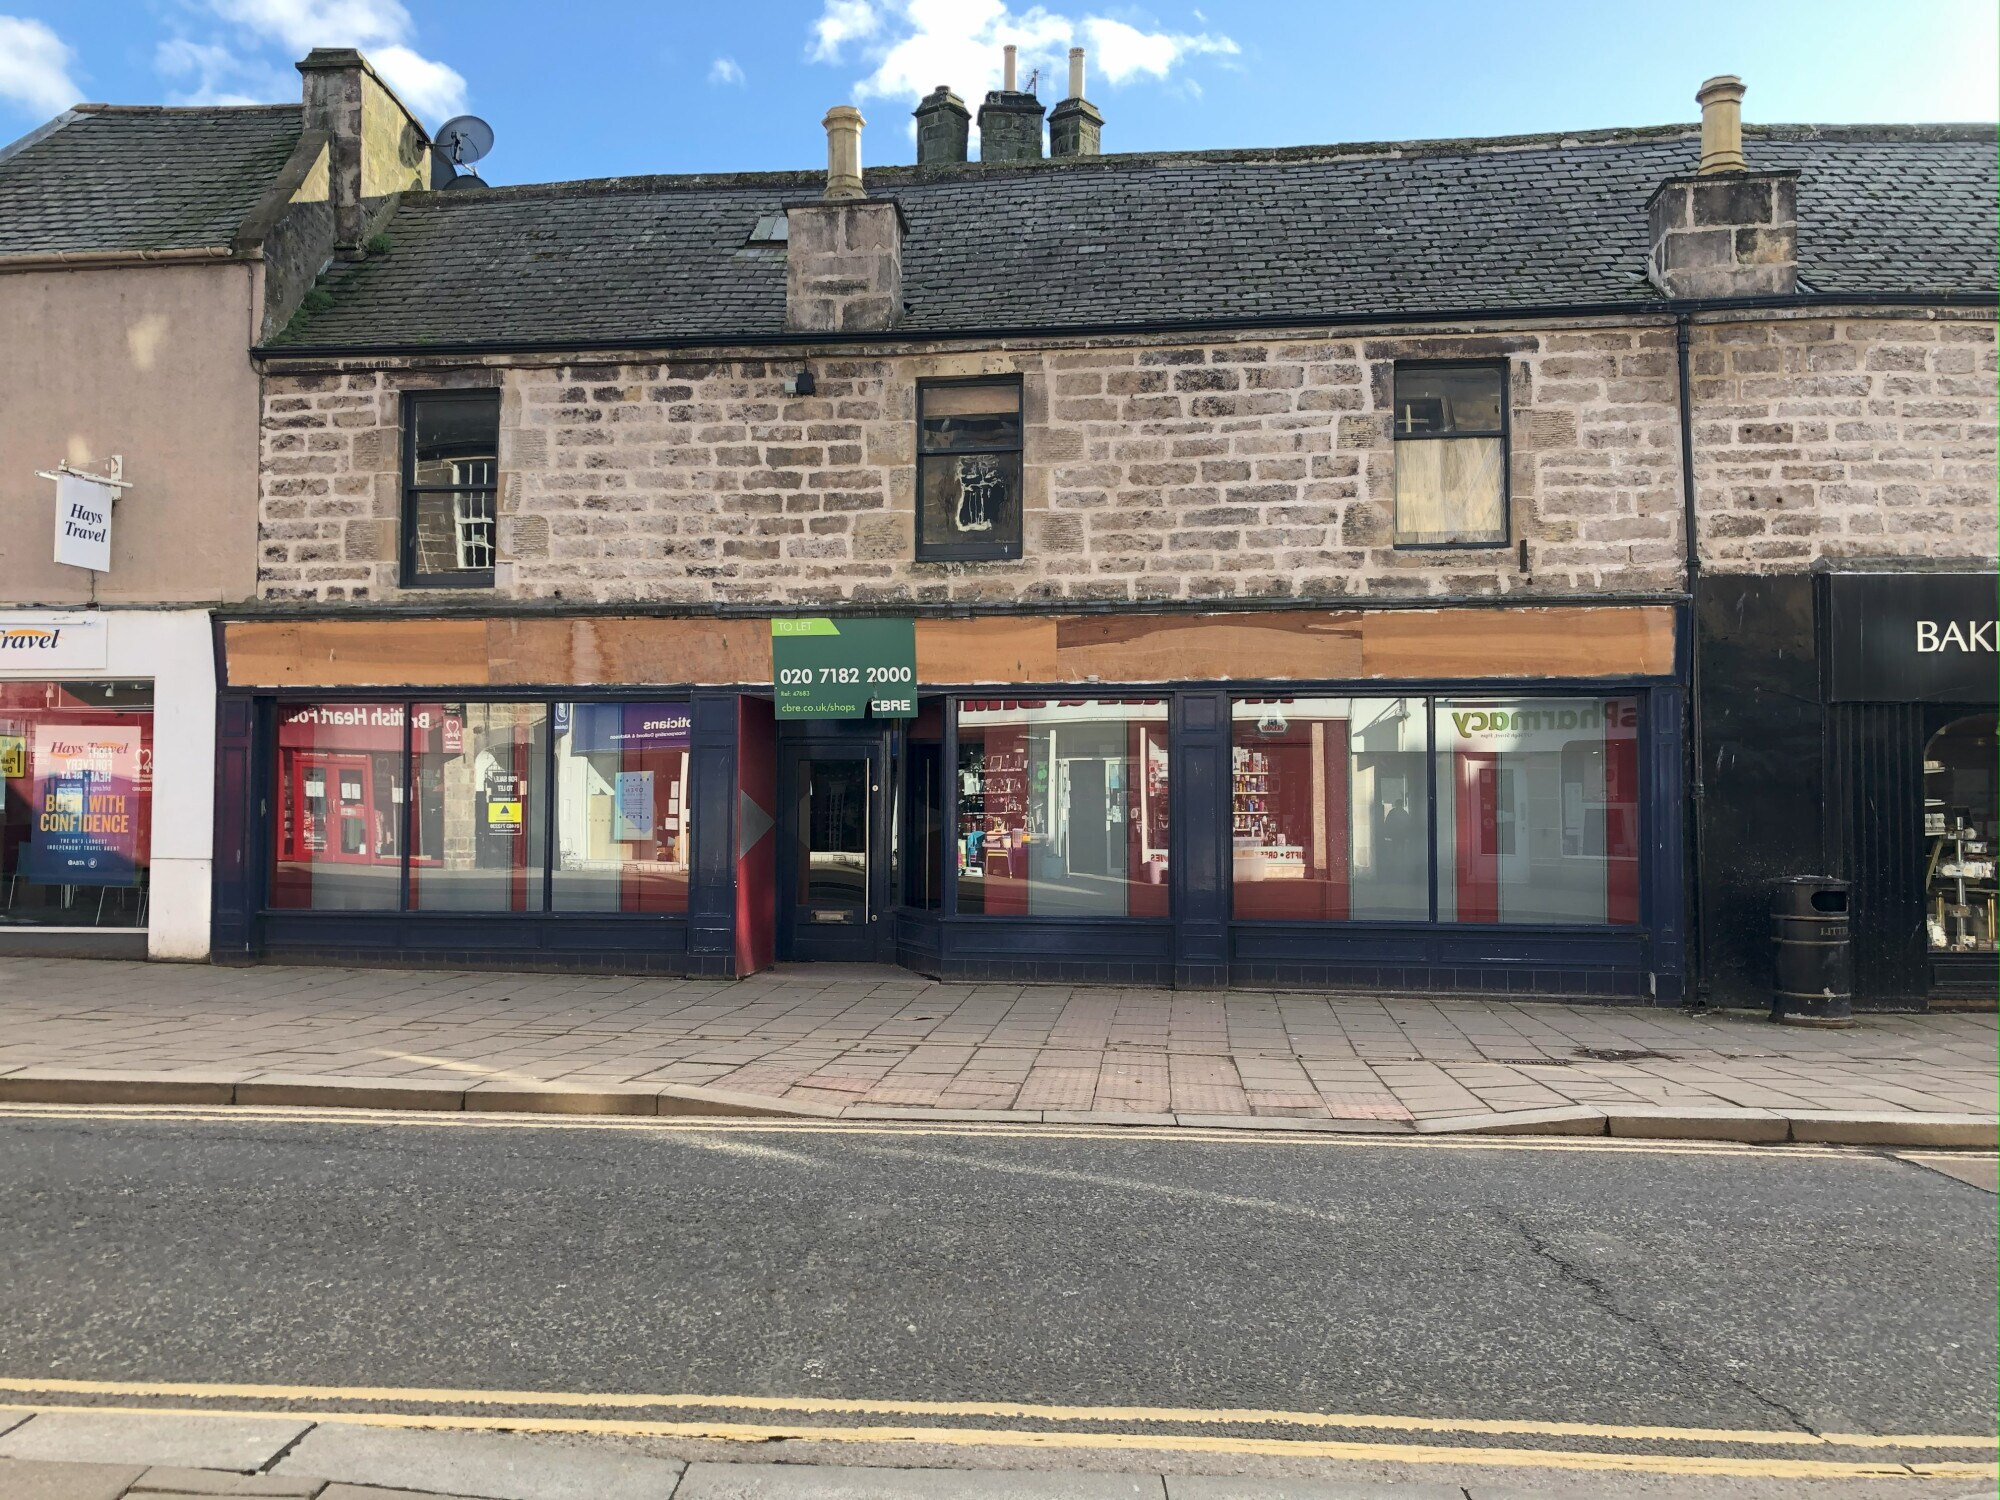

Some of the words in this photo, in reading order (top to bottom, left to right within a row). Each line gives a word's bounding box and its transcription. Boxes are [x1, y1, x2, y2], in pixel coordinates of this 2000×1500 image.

[70, 503, 103, 525] Hays
[65, 521, 107, 543] Travel
[778, 622, 793, 632] TO
[796, 622, 812, 631] LET
[780, 668, 813, 685] 020
[818, 667, 860, 684] 7182
[866, 666, 912, 683] 2000
[781, 702, 856, 713] cbre.co.uk/shops
[871, 700, 911, 711] CBRE
[50, 741, 84, 757] Hays
[89, 795, 126, 813] WITH
[40, 813, 129, 833] CONFIDENCE
